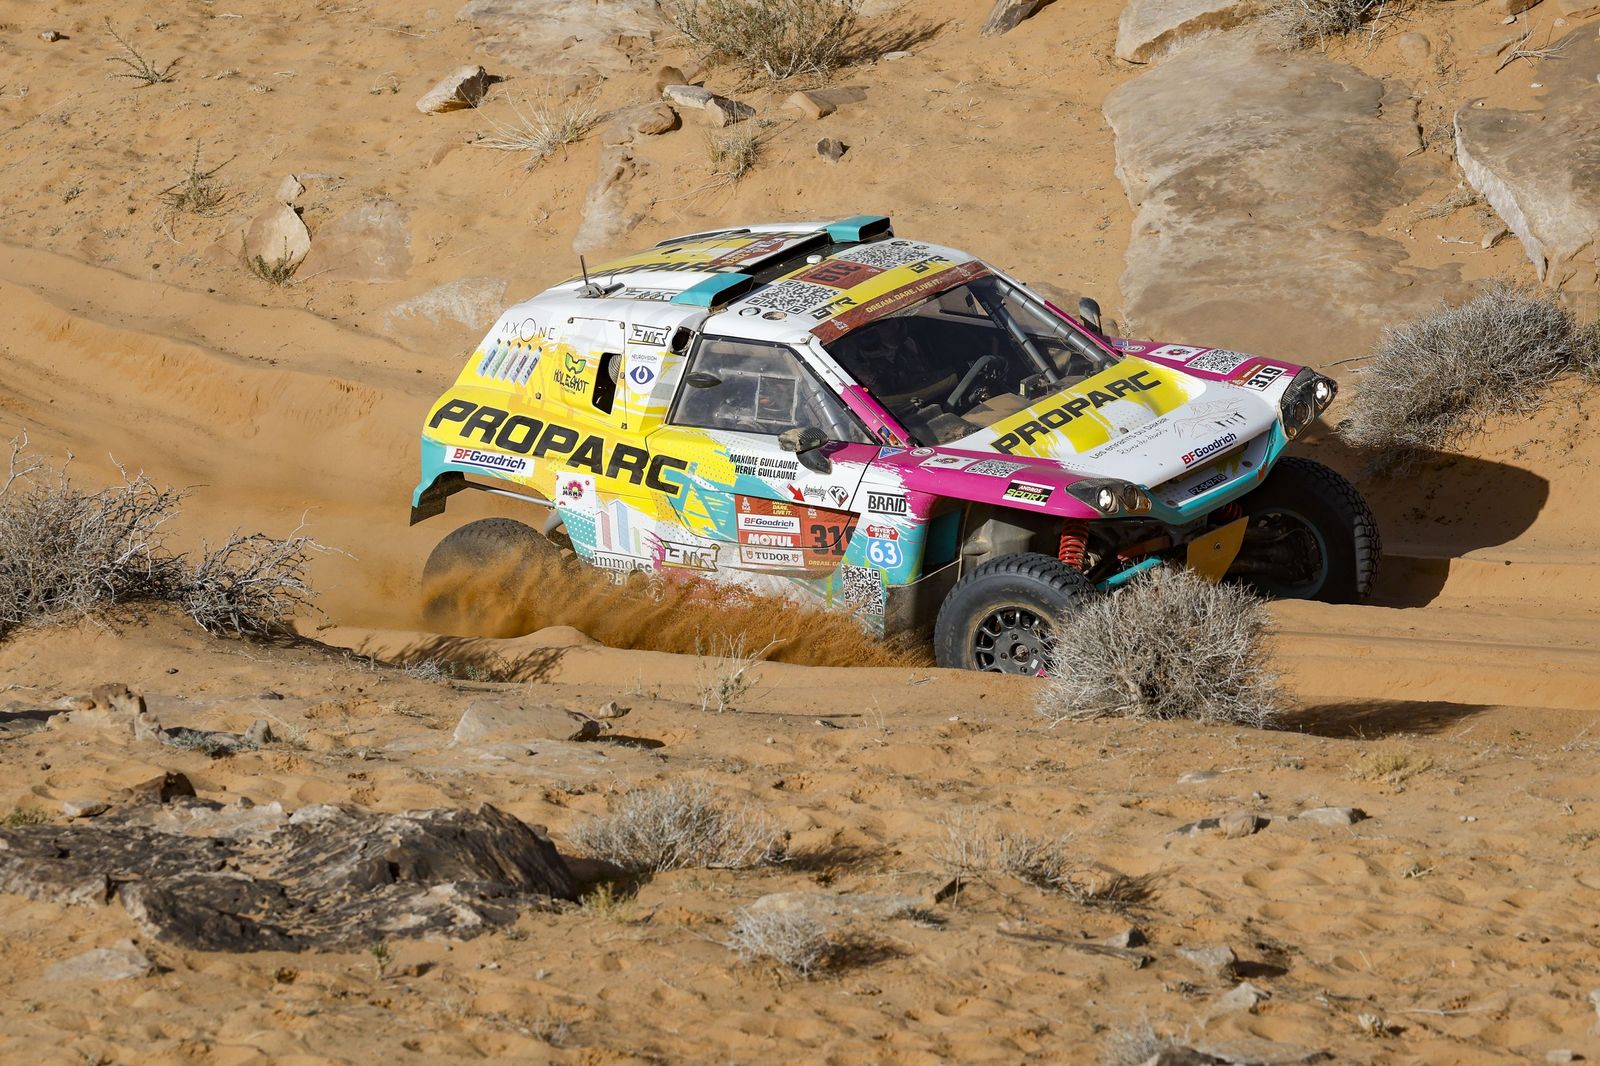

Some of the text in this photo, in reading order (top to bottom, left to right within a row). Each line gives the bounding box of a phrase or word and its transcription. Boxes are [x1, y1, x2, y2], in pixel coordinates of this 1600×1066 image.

[865, 297, 895, 313] DREAM.
[894, 289, 917, 300] DARE.
[916, 281, 933, 292] LIVE
[501, 317, 556, 342] AXONE
[553, 368, 589, 394] HOLESHOT
[1247, 367, 1283, 388] 319
[990, 370, 1162, 455] PROPARC
[428, 398, 688, 495] PROPARC
[1181, 432, 1238, 466] BFGoodrich
[452, 448, 527, 471] BFGoodrich
[729, 454, 799, 471] MAXIME GUILLAUME
[757, 467, 797, 481] GUILLAUME
[562, 490, 583, 498] MAMA
[1006, 488, 1049, 503] SPORT
[1018, 485, 1042, 494] ANDROS
[867, 495, 907, 513] BRAID
[744, 517, 795, 528] BFGoodrich
[869, 526, 896, 535] DRIVER'S
[748, 533, 795, 548] MOTUL
[755, 552, 791, 562] TUDOR
[870, 541, 898, 565] 63
